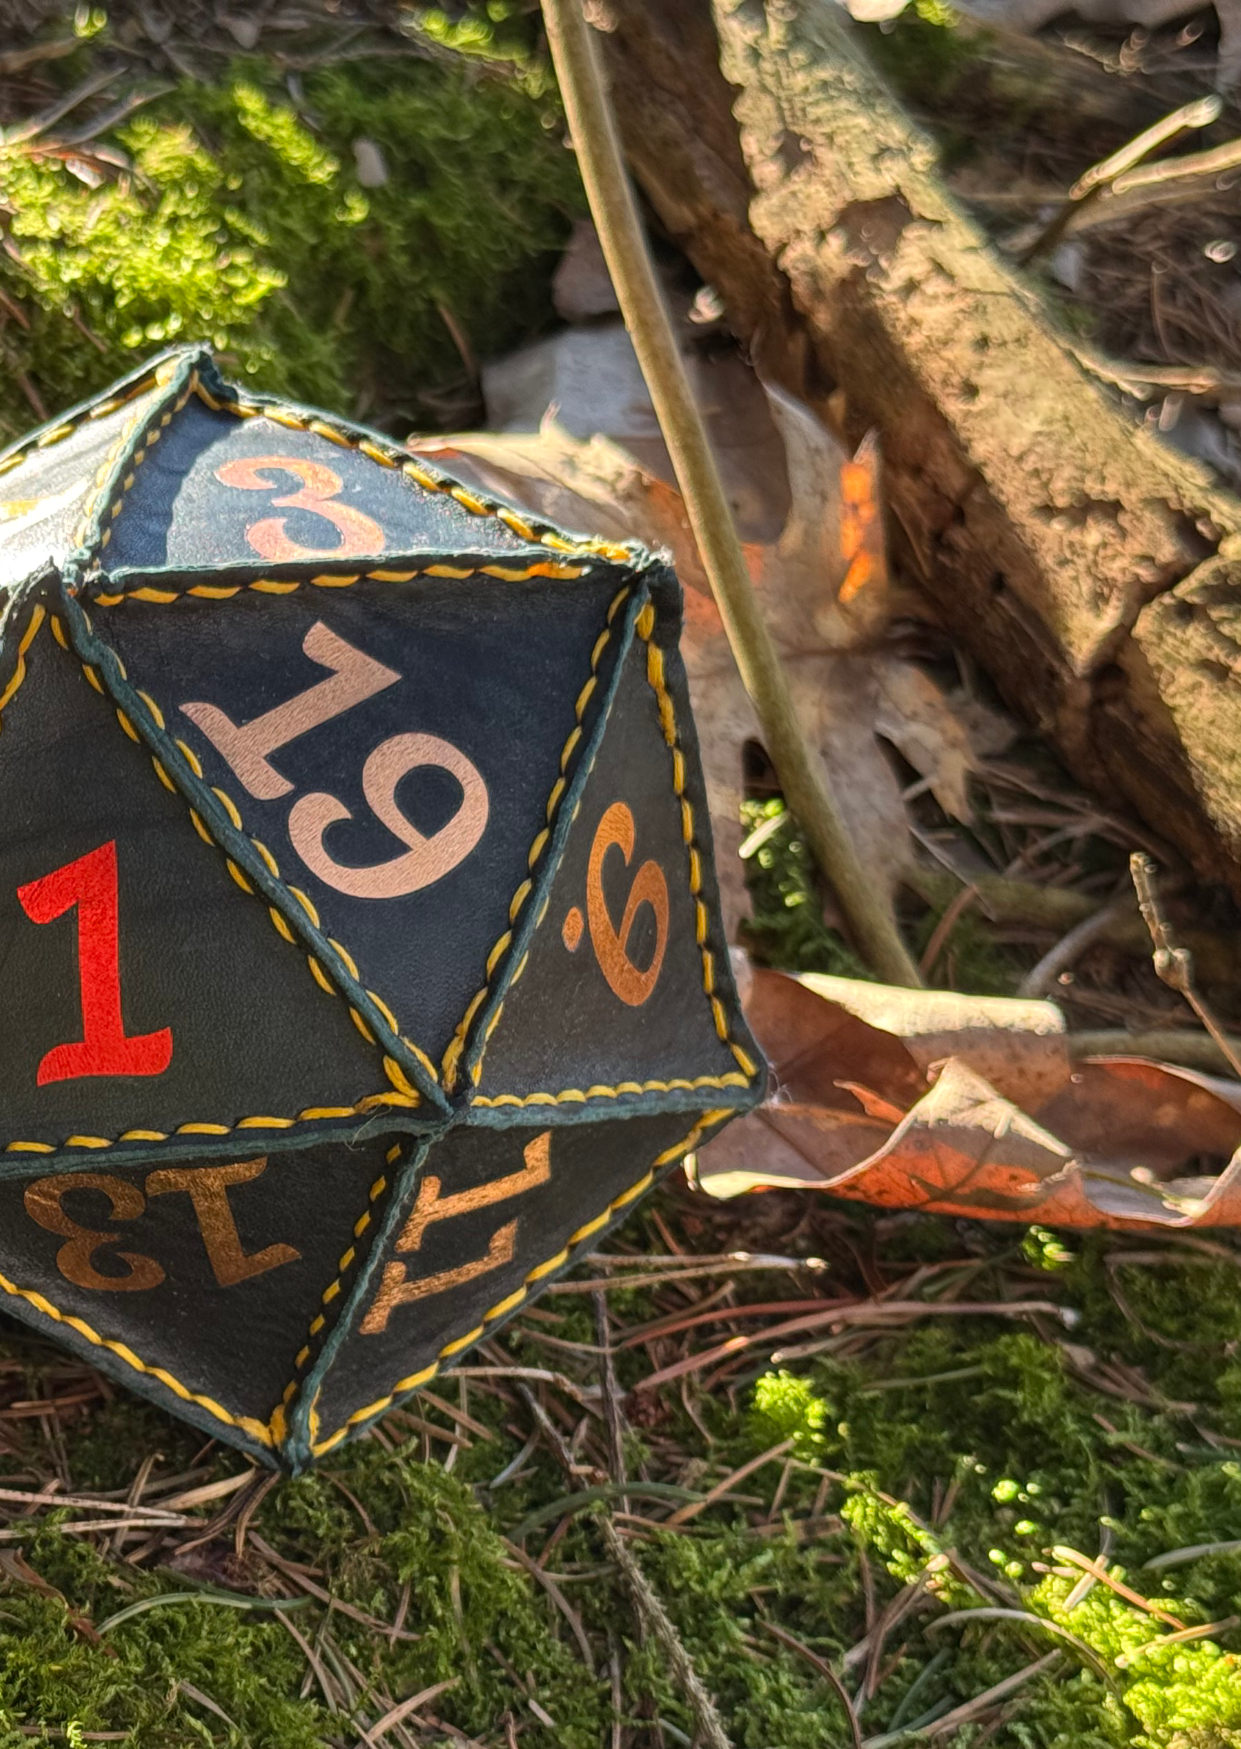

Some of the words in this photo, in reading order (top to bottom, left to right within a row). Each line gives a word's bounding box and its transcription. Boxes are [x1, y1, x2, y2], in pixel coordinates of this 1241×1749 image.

[214, 456, 385, 560] 3
[178, 621, 490, 899] 19
[17, 839, 173, 1087] 1
[23, 1157, 302, 1292] 13
[359, 1131, 552, 1335] 11
